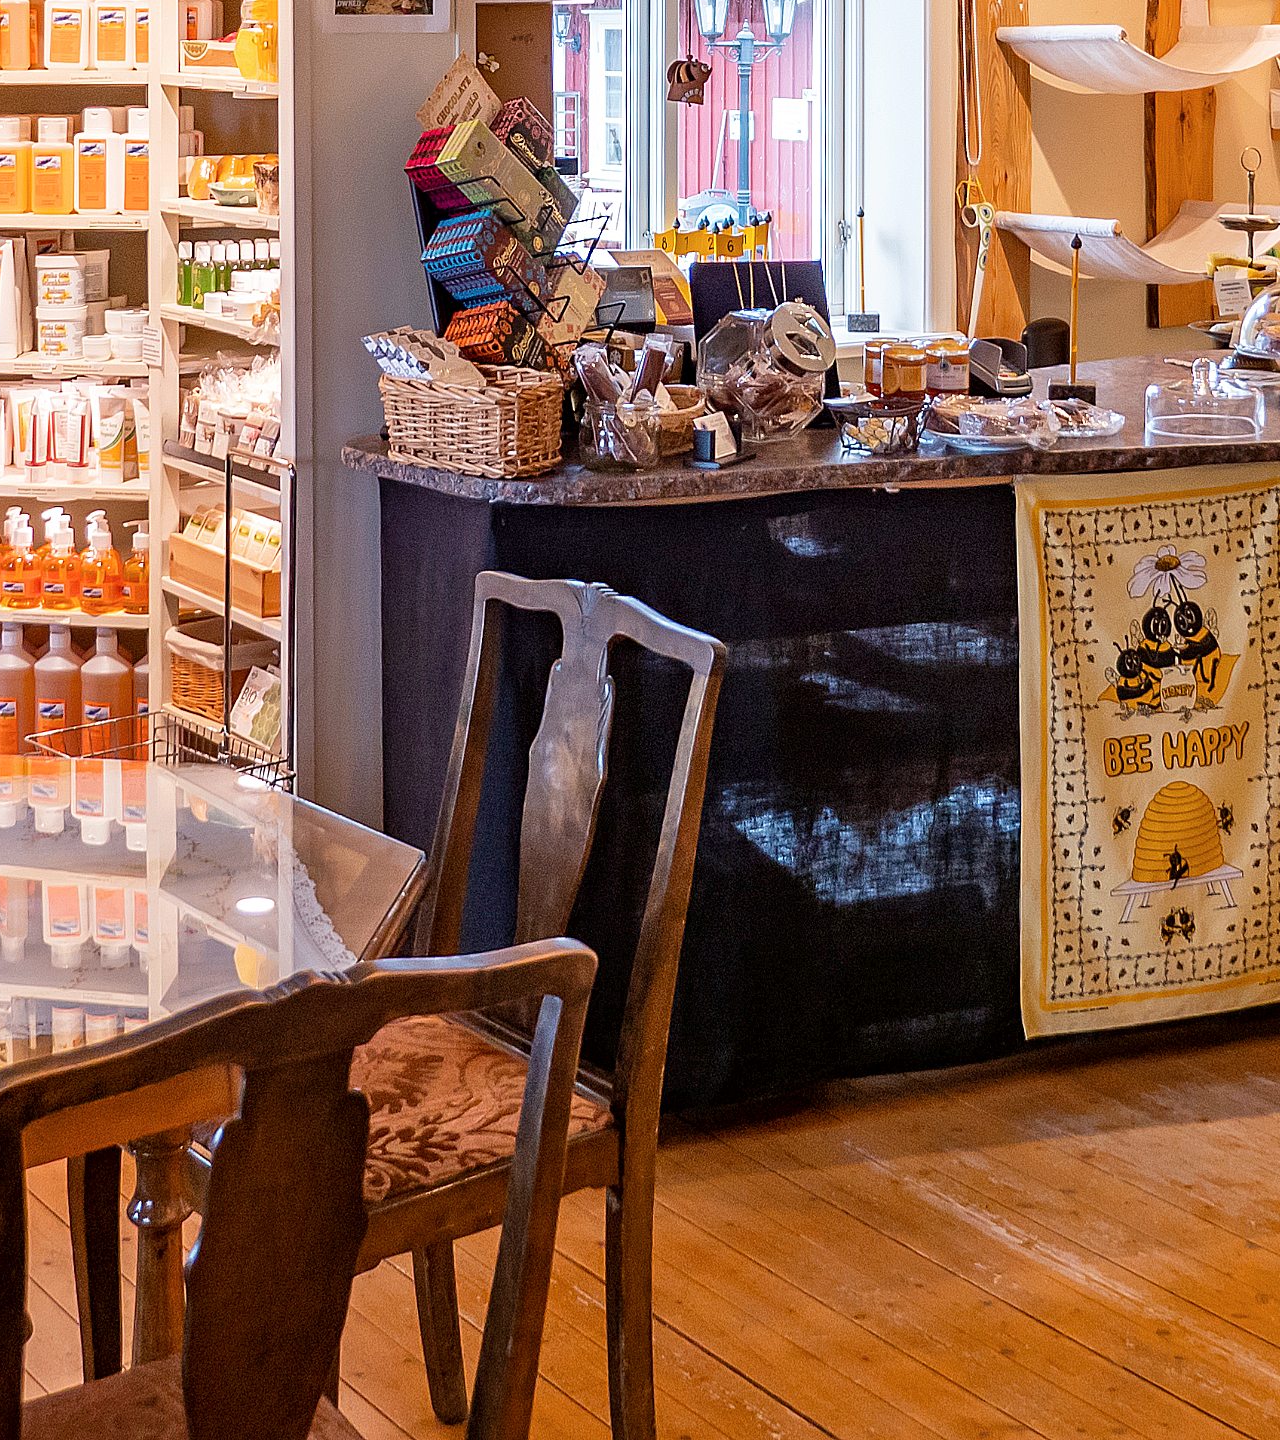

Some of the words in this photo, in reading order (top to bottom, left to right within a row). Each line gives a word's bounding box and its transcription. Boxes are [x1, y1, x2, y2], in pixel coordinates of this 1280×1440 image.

[436, 75, 472, 126] CHOCOLATE
[661, 237, 668, 250] 8
[707, 236, 715, 250] 2
[727, 240, 734, 253] 6
[241, 686, 258, 705] BIO
[1161, 683, 1196, 700] HONEY
[1103, 733, 1154, 778] BEE
[1162, 720, 1250, 770] HAPPY
